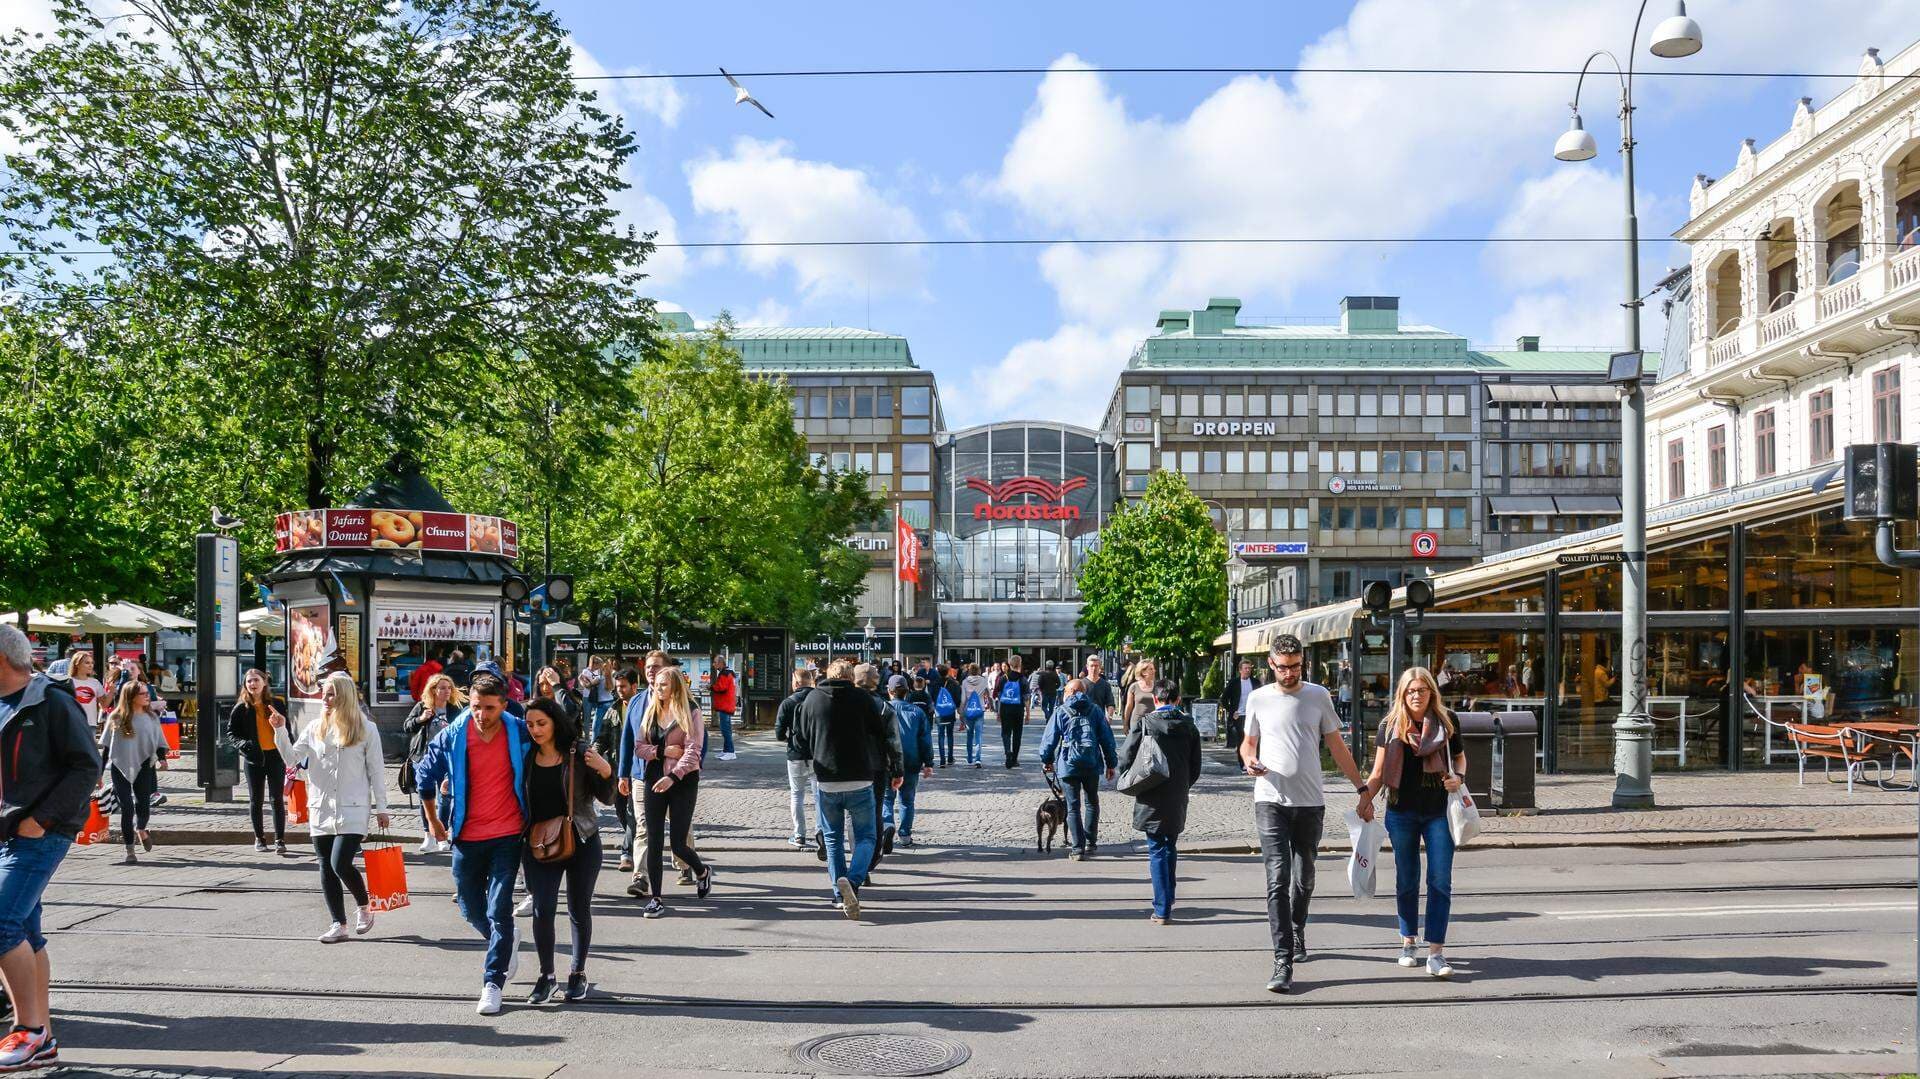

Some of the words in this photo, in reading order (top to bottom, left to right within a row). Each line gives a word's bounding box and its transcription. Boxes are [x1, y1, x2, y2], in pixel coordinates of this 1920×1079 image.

[1193, 422, 1276, 436] DROPPEN
[331, 515, 366, 529] Jafaris
[328, 530, 369, 541] Donuts
[425, 526, 465, 538] Churros
[1245, 544, 1307, 553] INTERSPORT
